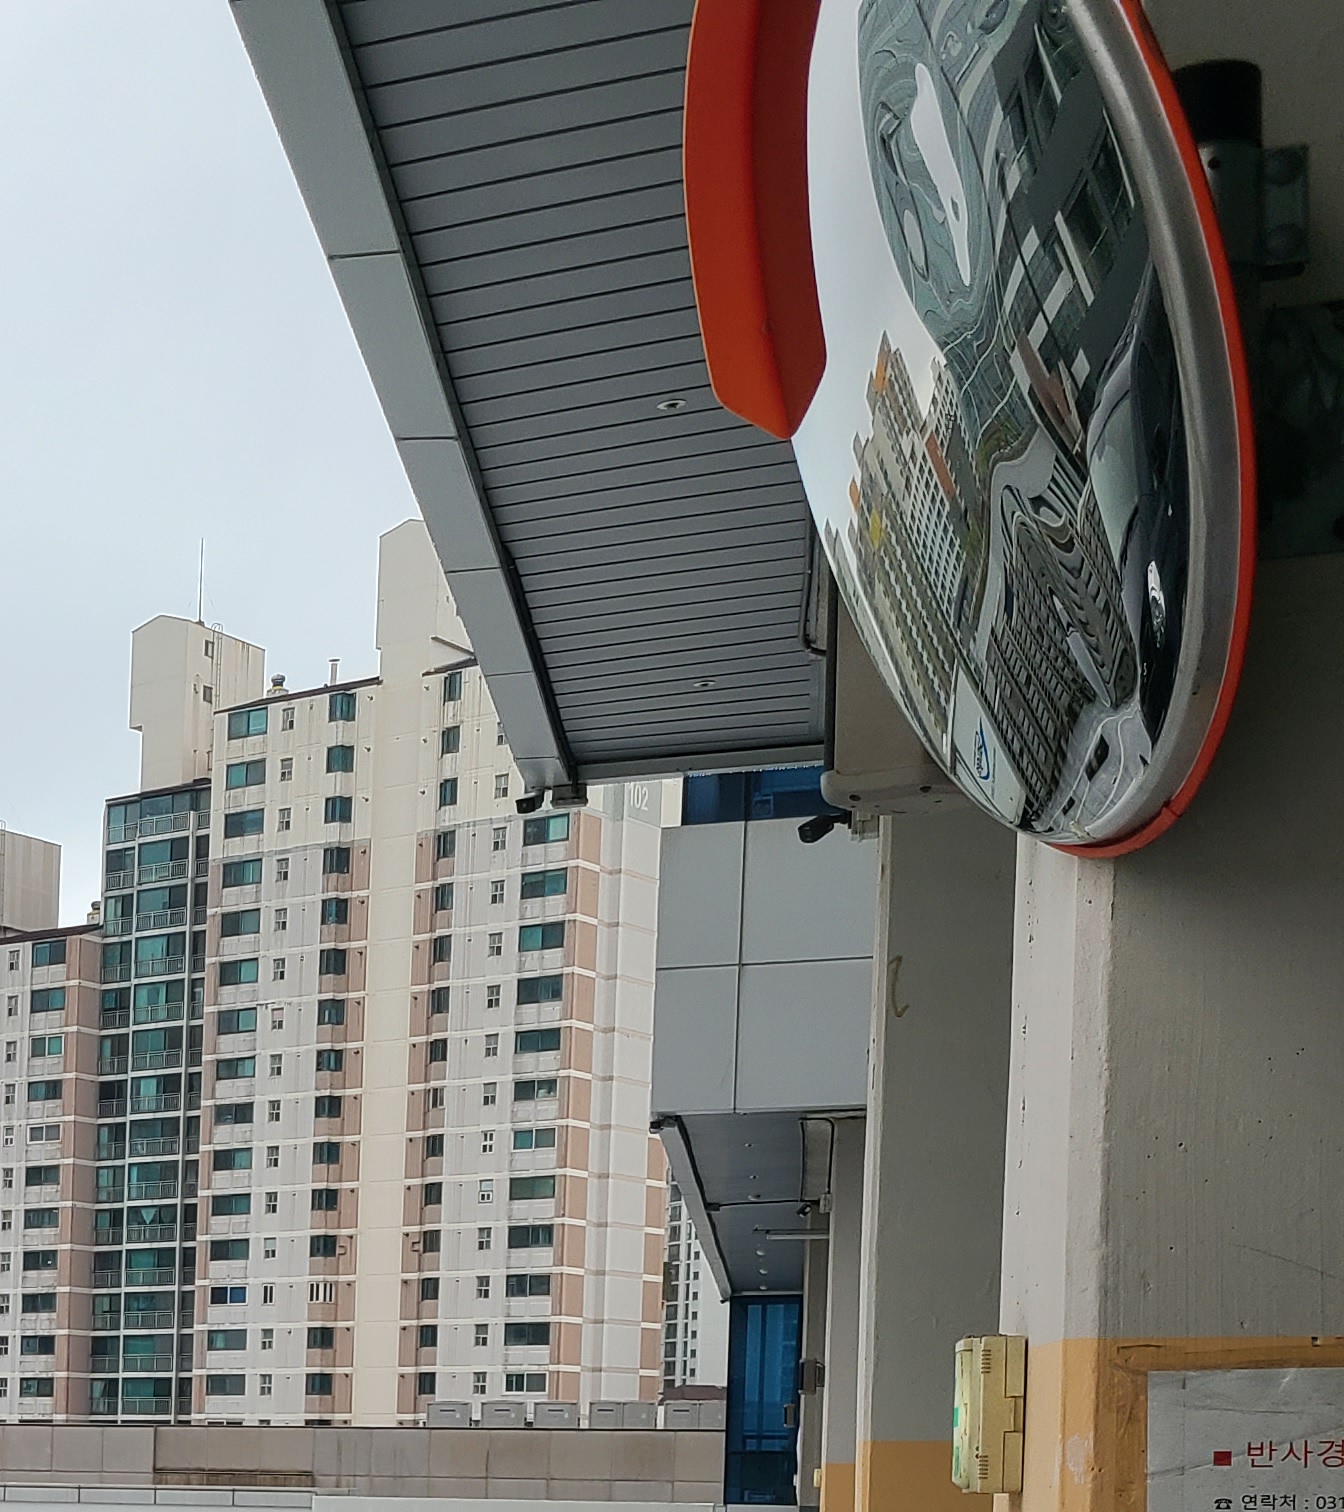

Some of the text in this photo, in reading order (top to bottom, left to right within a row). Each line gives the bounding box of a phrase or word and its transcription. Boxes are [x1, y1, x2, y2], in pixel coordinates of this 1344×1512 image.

[629, 783, 650, 811] 102
[1247, 1440, 1344, 1469] 반사경
[1241, 1494, 1296, 1511] 연락처
